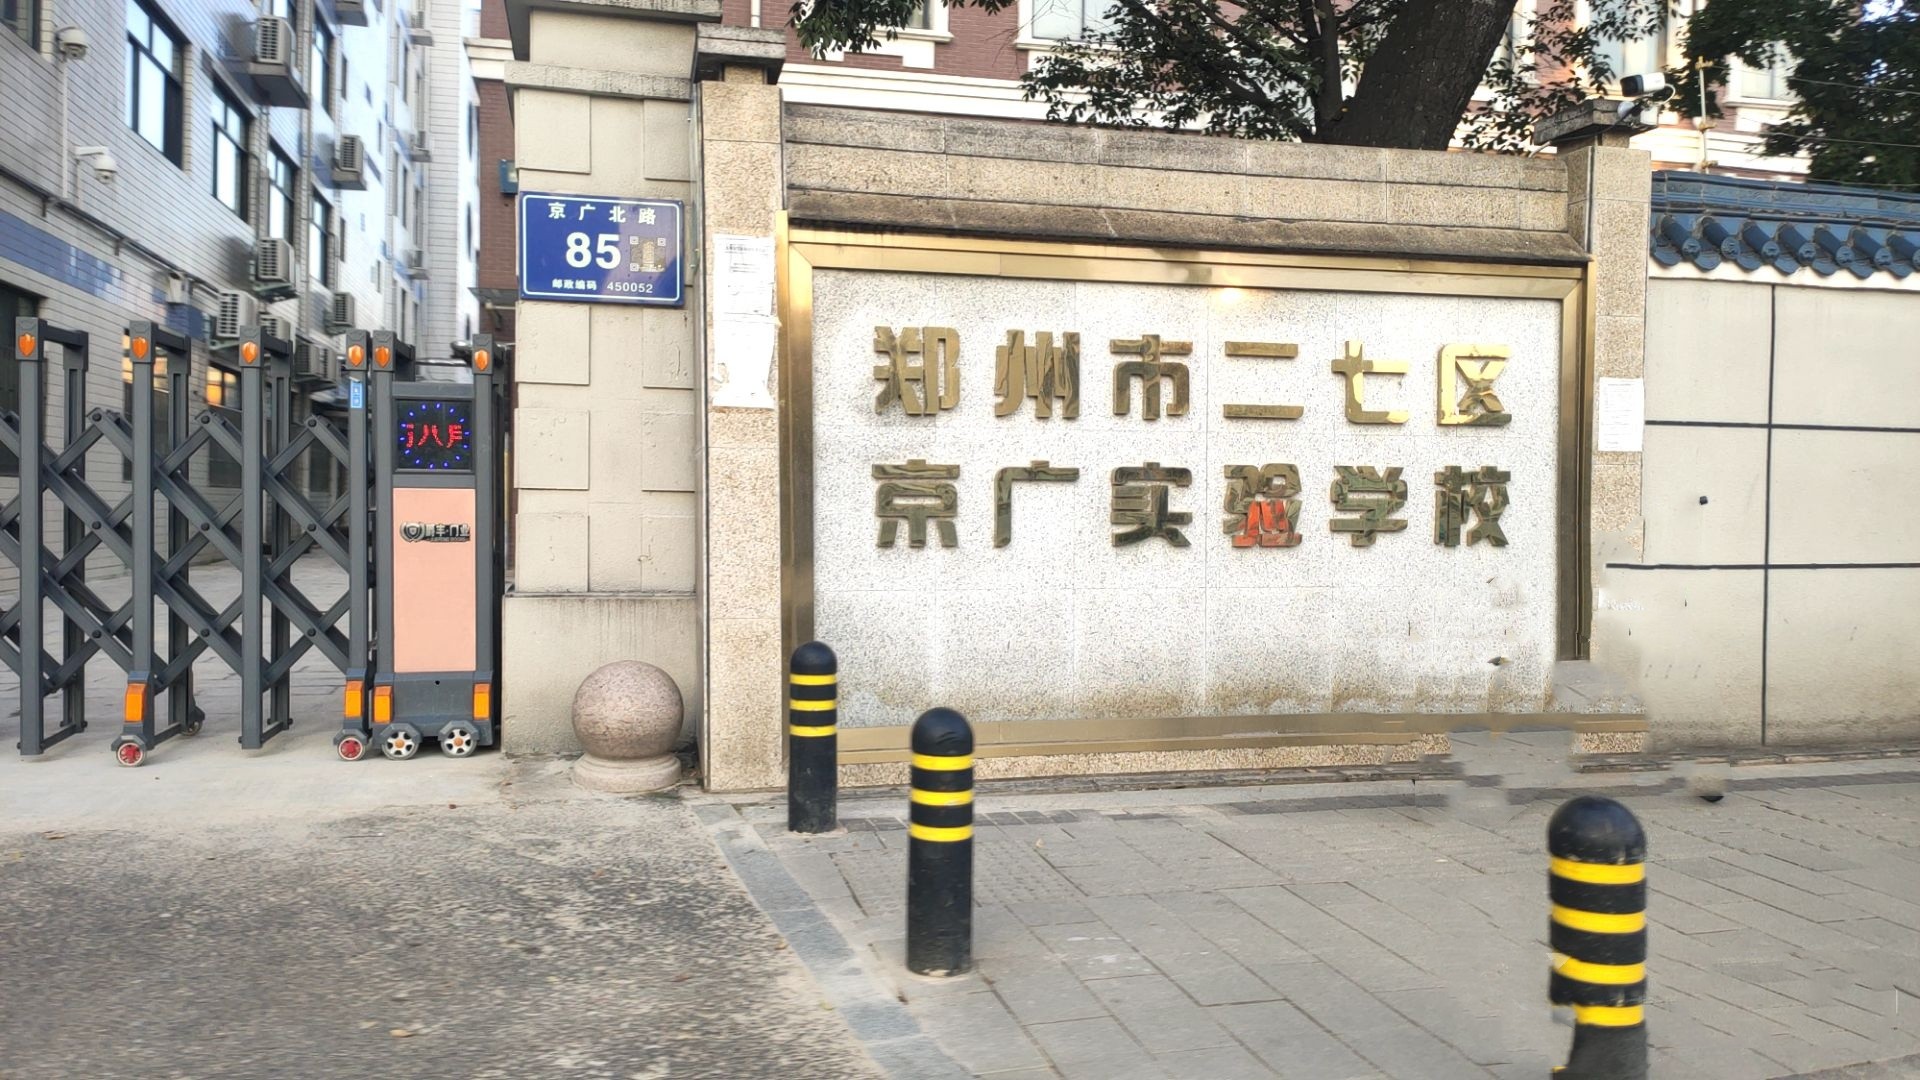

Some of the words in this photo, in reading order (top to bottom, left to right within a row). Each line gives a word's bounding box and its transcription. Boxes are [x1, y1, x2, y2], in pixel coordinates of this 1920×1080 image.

[548, 202, 657, 226] 京广北路
[565, 231, 622, 270] 85
[552, 278, 597, 291] 邮政编码
[606, 281, 654, 294] 450052
[873, 325, 1513, 427] 郑州市二七区
[872, 458, 1512, 548] 京广实验学校
